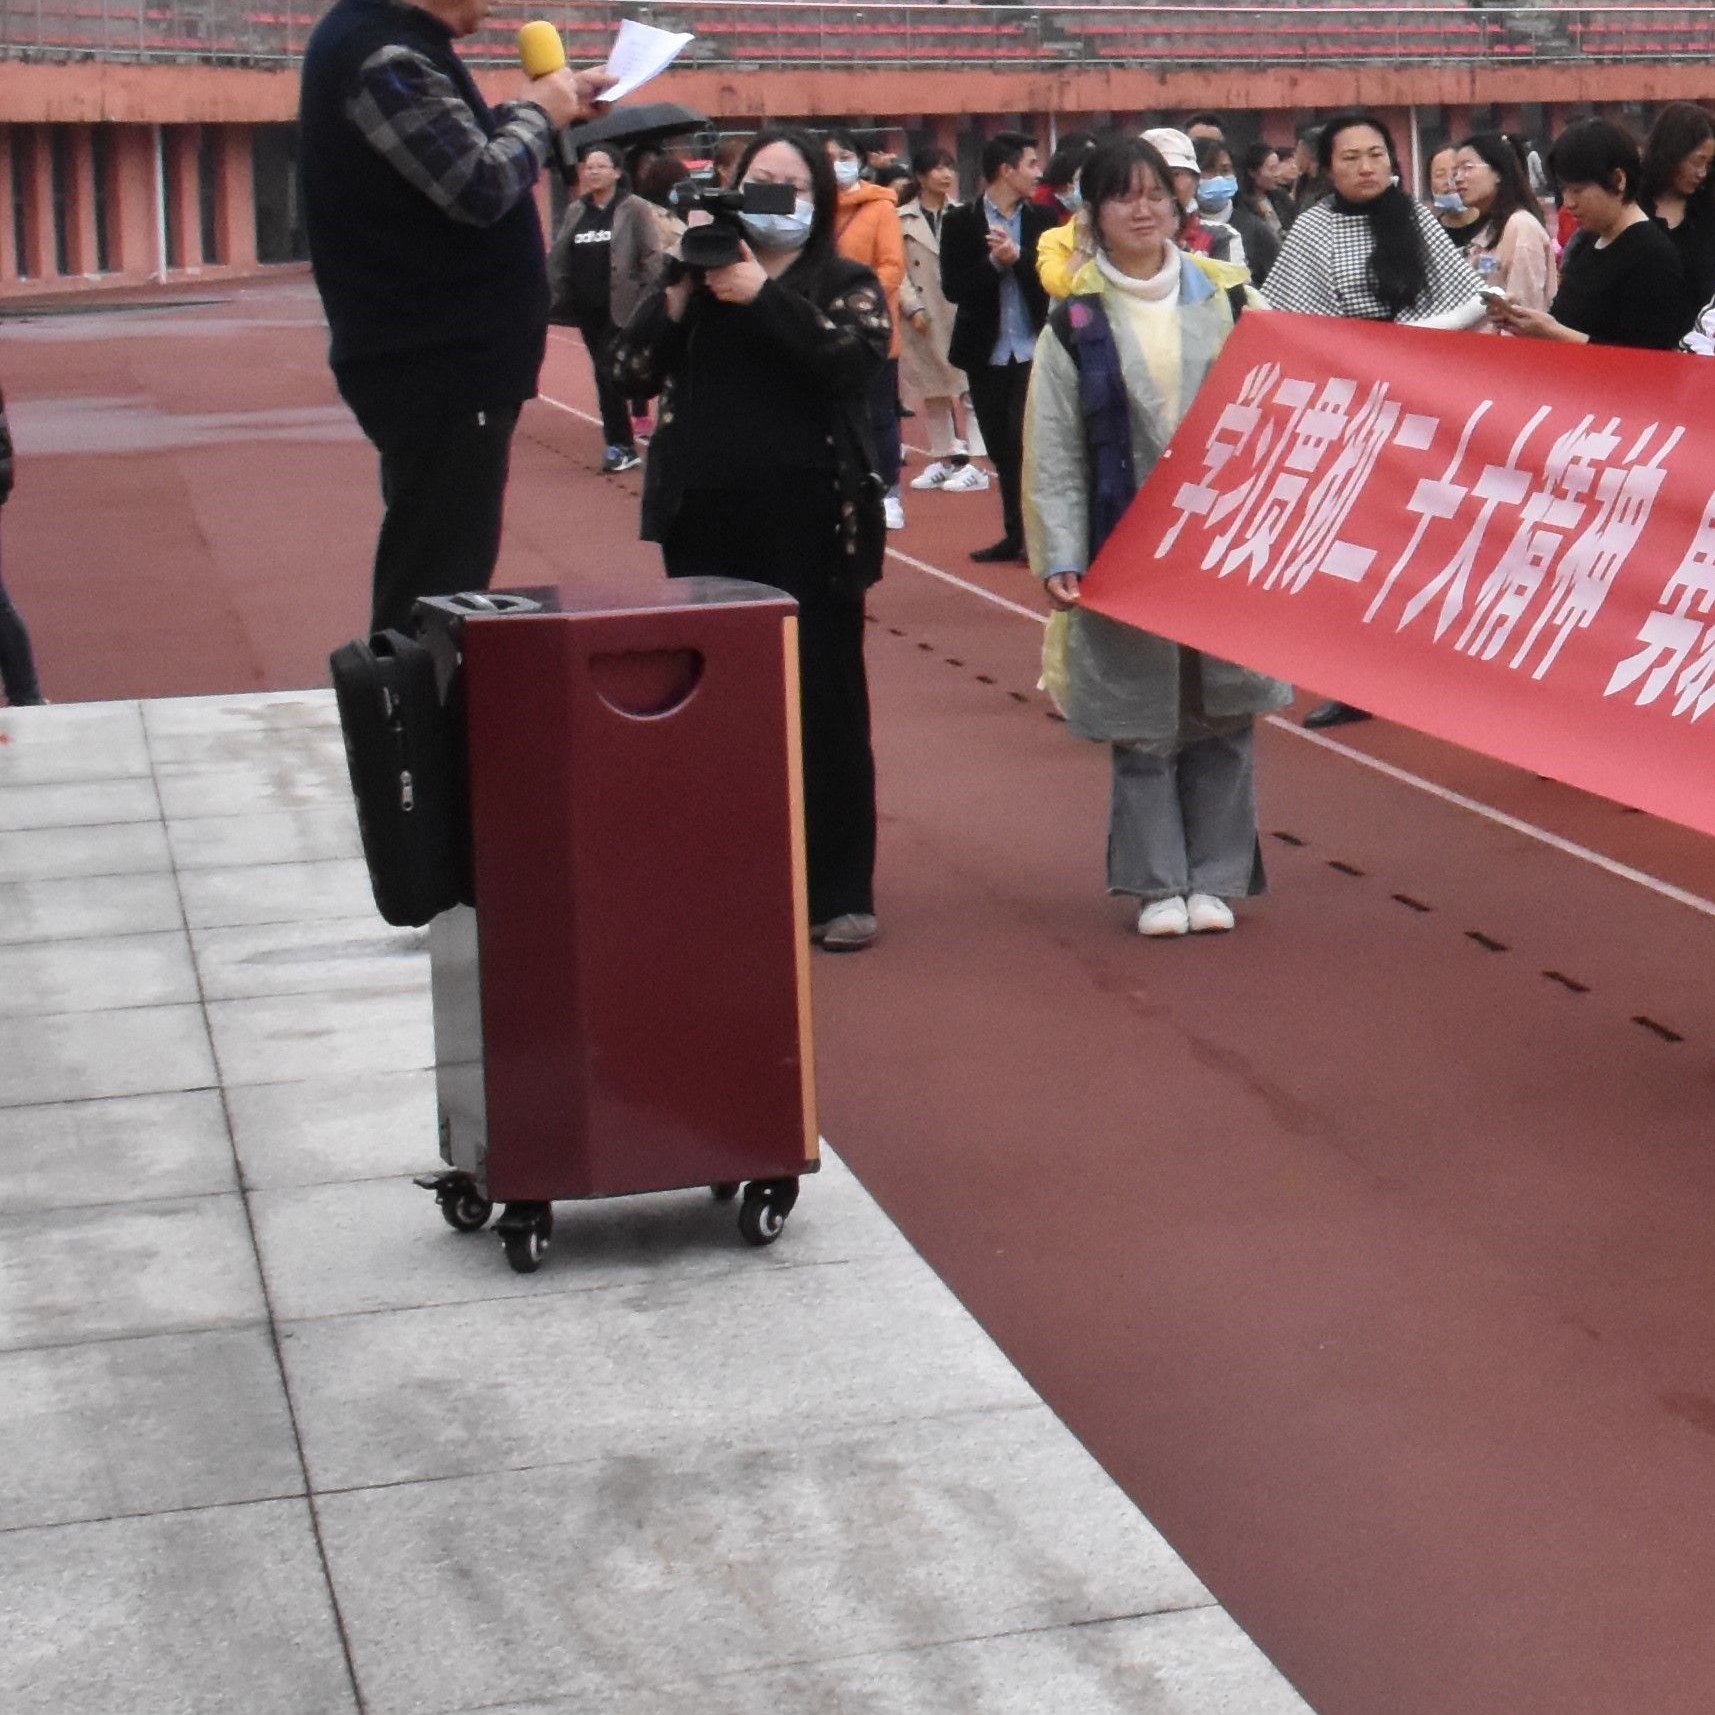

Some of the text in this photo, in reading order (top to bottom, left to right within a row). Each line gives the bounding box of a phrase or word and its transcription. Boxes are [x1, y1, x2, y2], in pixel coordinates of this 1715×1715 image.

[574, 230, 612, 244] adida
[1154, 362, 1686, 681] 学习贯彻二十大精神
